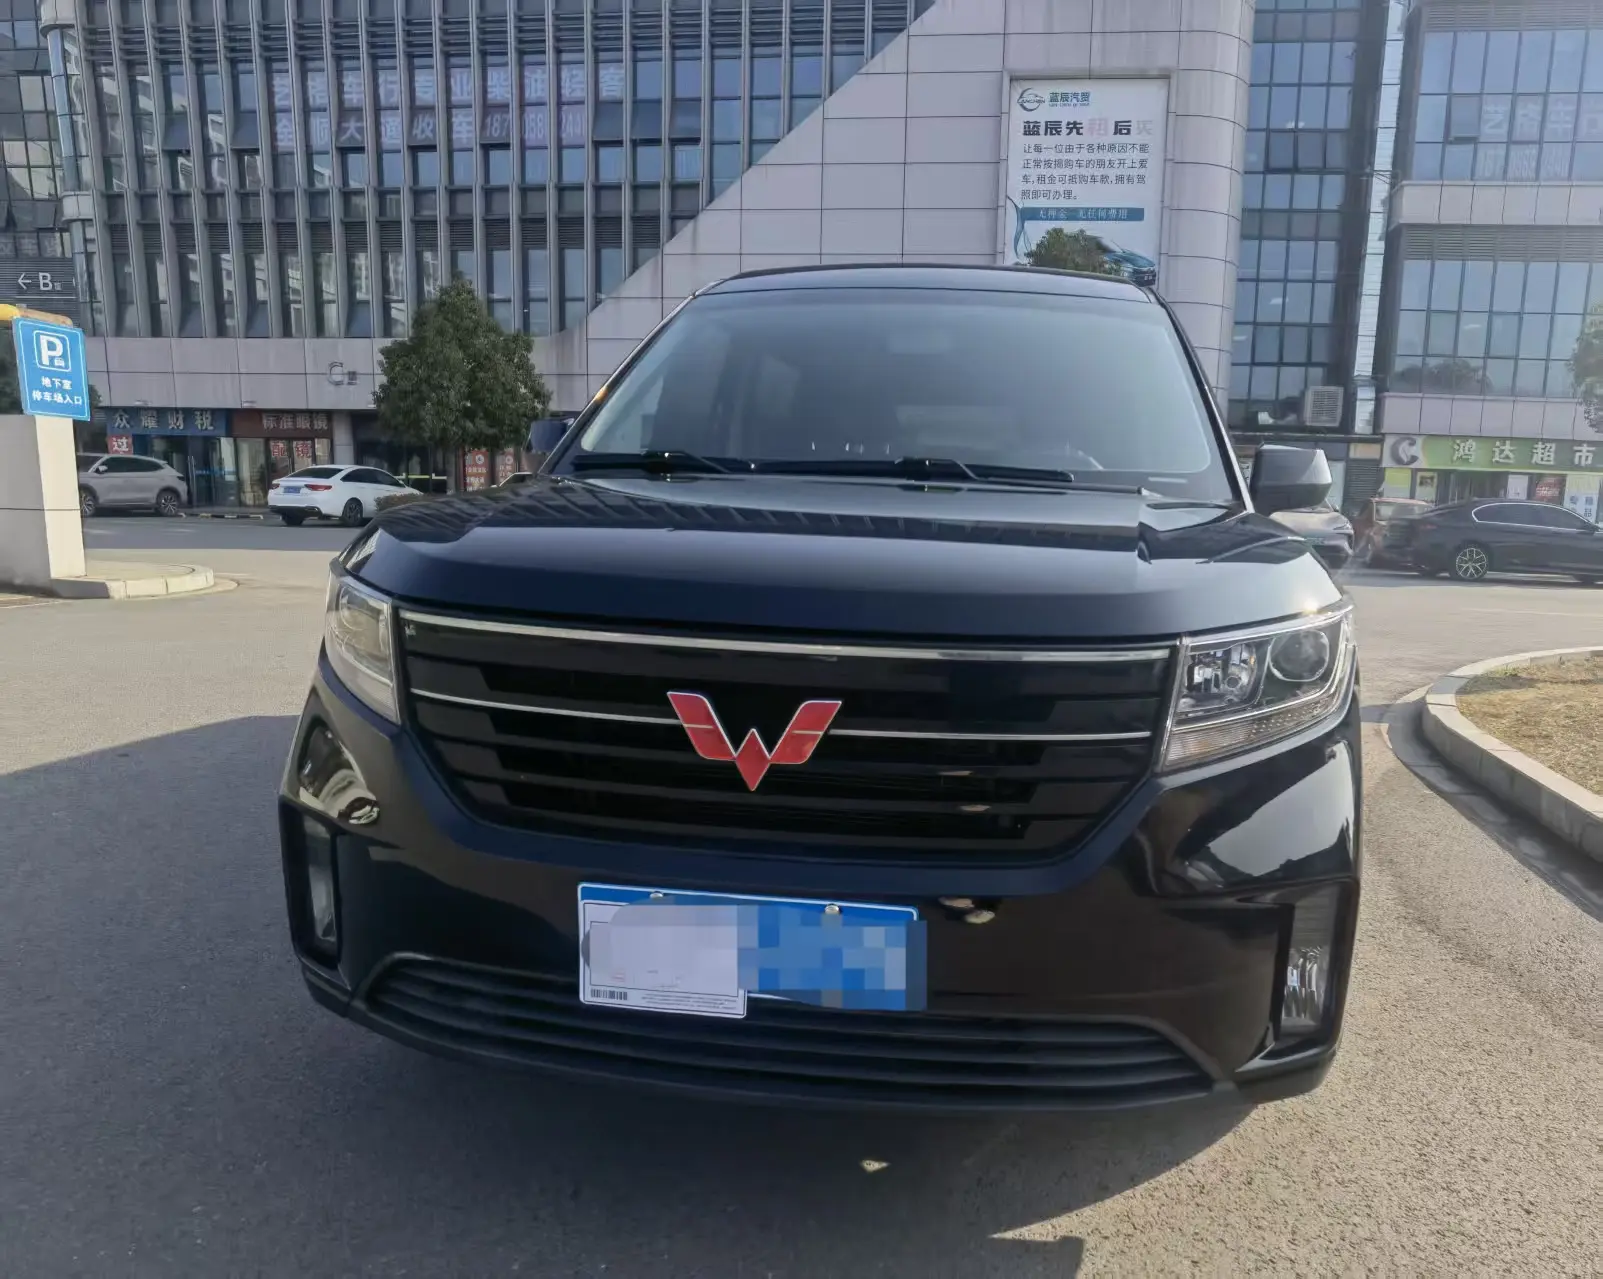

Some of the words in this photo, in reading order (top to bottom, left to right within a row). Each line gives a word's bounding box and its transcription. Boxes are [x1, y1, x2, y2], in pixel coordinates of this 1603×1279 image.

[1049, 91, 1091, 103] 蓝辰汽贸
[1023, 143, 1149, 154] 让每一位由于各种原因不能
[1022, 158, 1148, 169] 正常按揭购车的朋友开上爱
[39, 334, 64, 366] P
[41, 375, 72, 390] 地下室
[32, 389, 82, 406] 停车场入口
[113, 409, 215, 431] 众耀财税
[262, 411, 329, 430] 标准眼镜
[112, 437, 129, 452] 过
[1453, 439, 1596, 467] 鸿达超市
